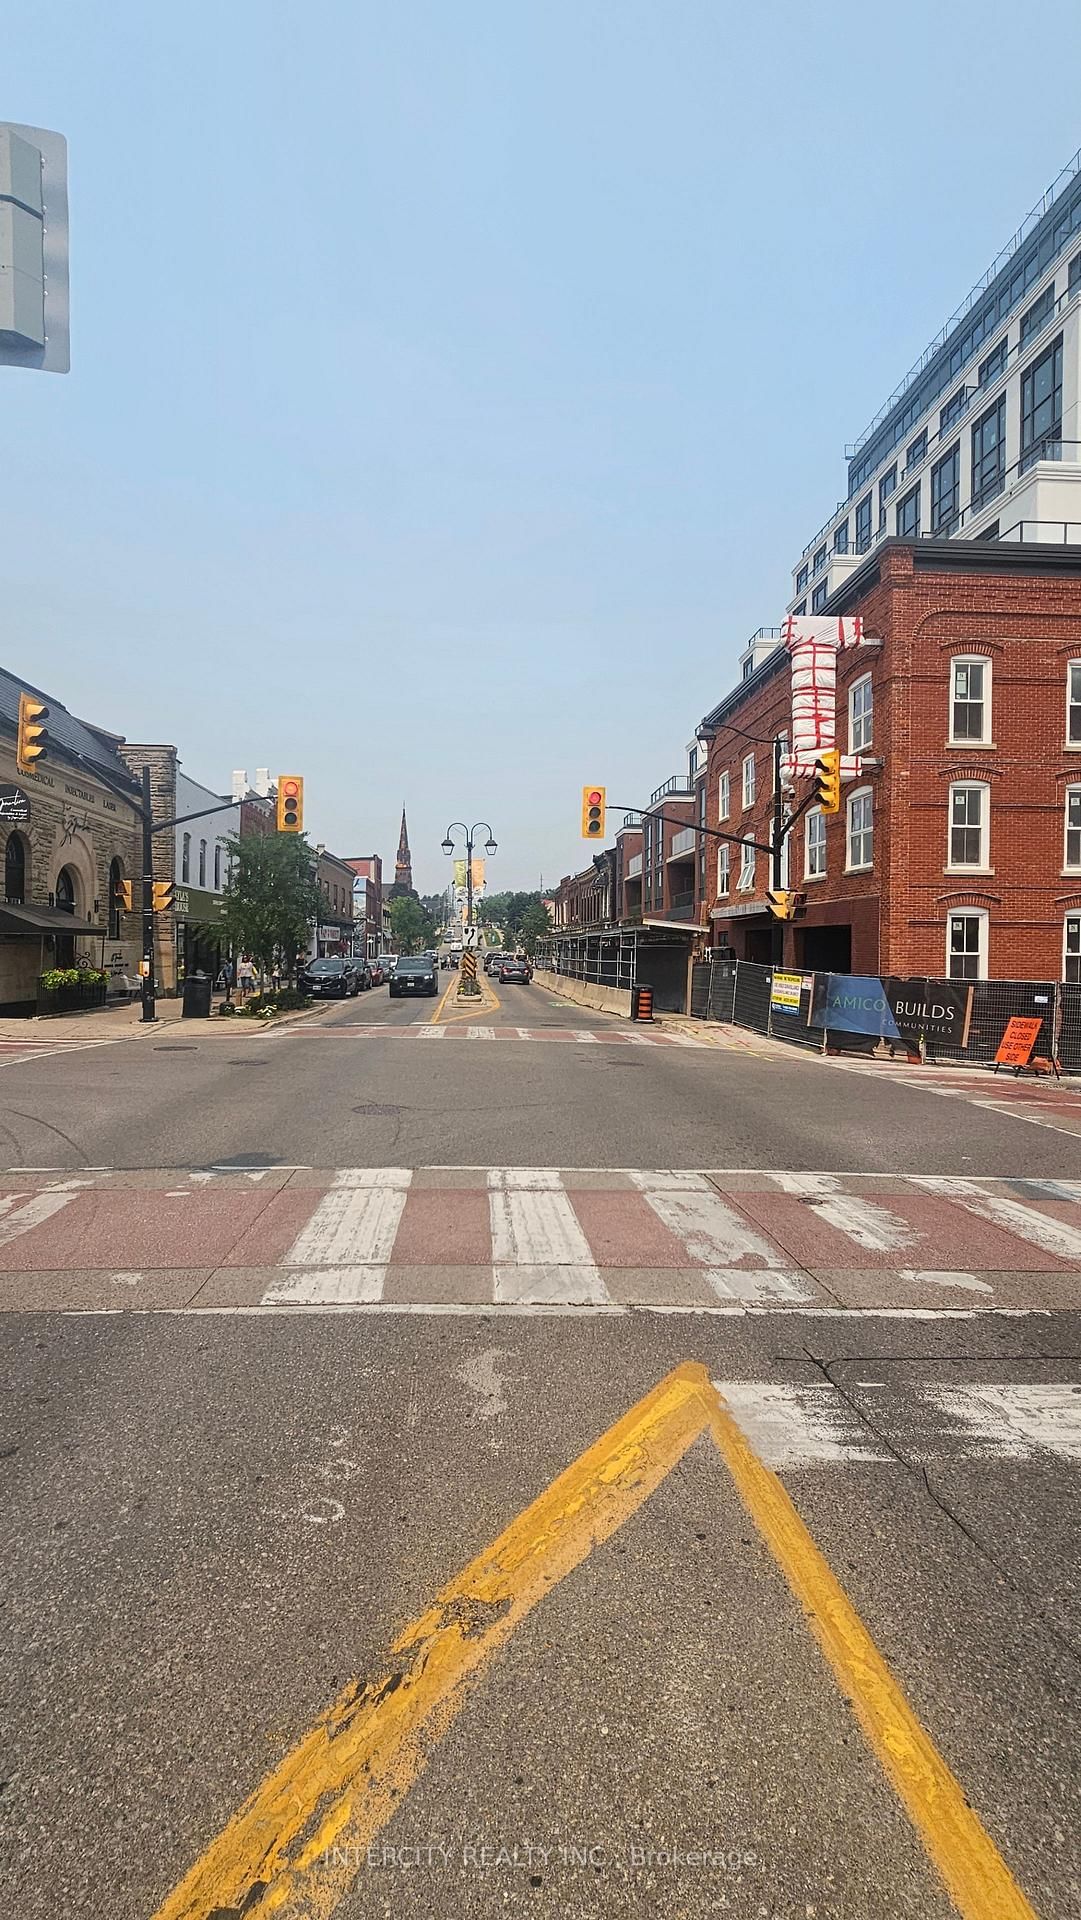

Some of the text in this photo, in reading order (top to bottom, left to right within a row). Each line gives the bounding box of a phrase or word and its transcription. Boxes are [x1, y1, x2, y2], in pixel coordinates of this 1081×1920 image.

[832, 996, 955, 1020] AMICO BUILDS
[882, 1019, 953, 1034] COMMUNITIES
[1009, 1031, 1032, 1041] CLOSED
[1000, 1041, 1031, 1052] USE OTHER
[1005, 1052, 1020, 1062] SIDE
